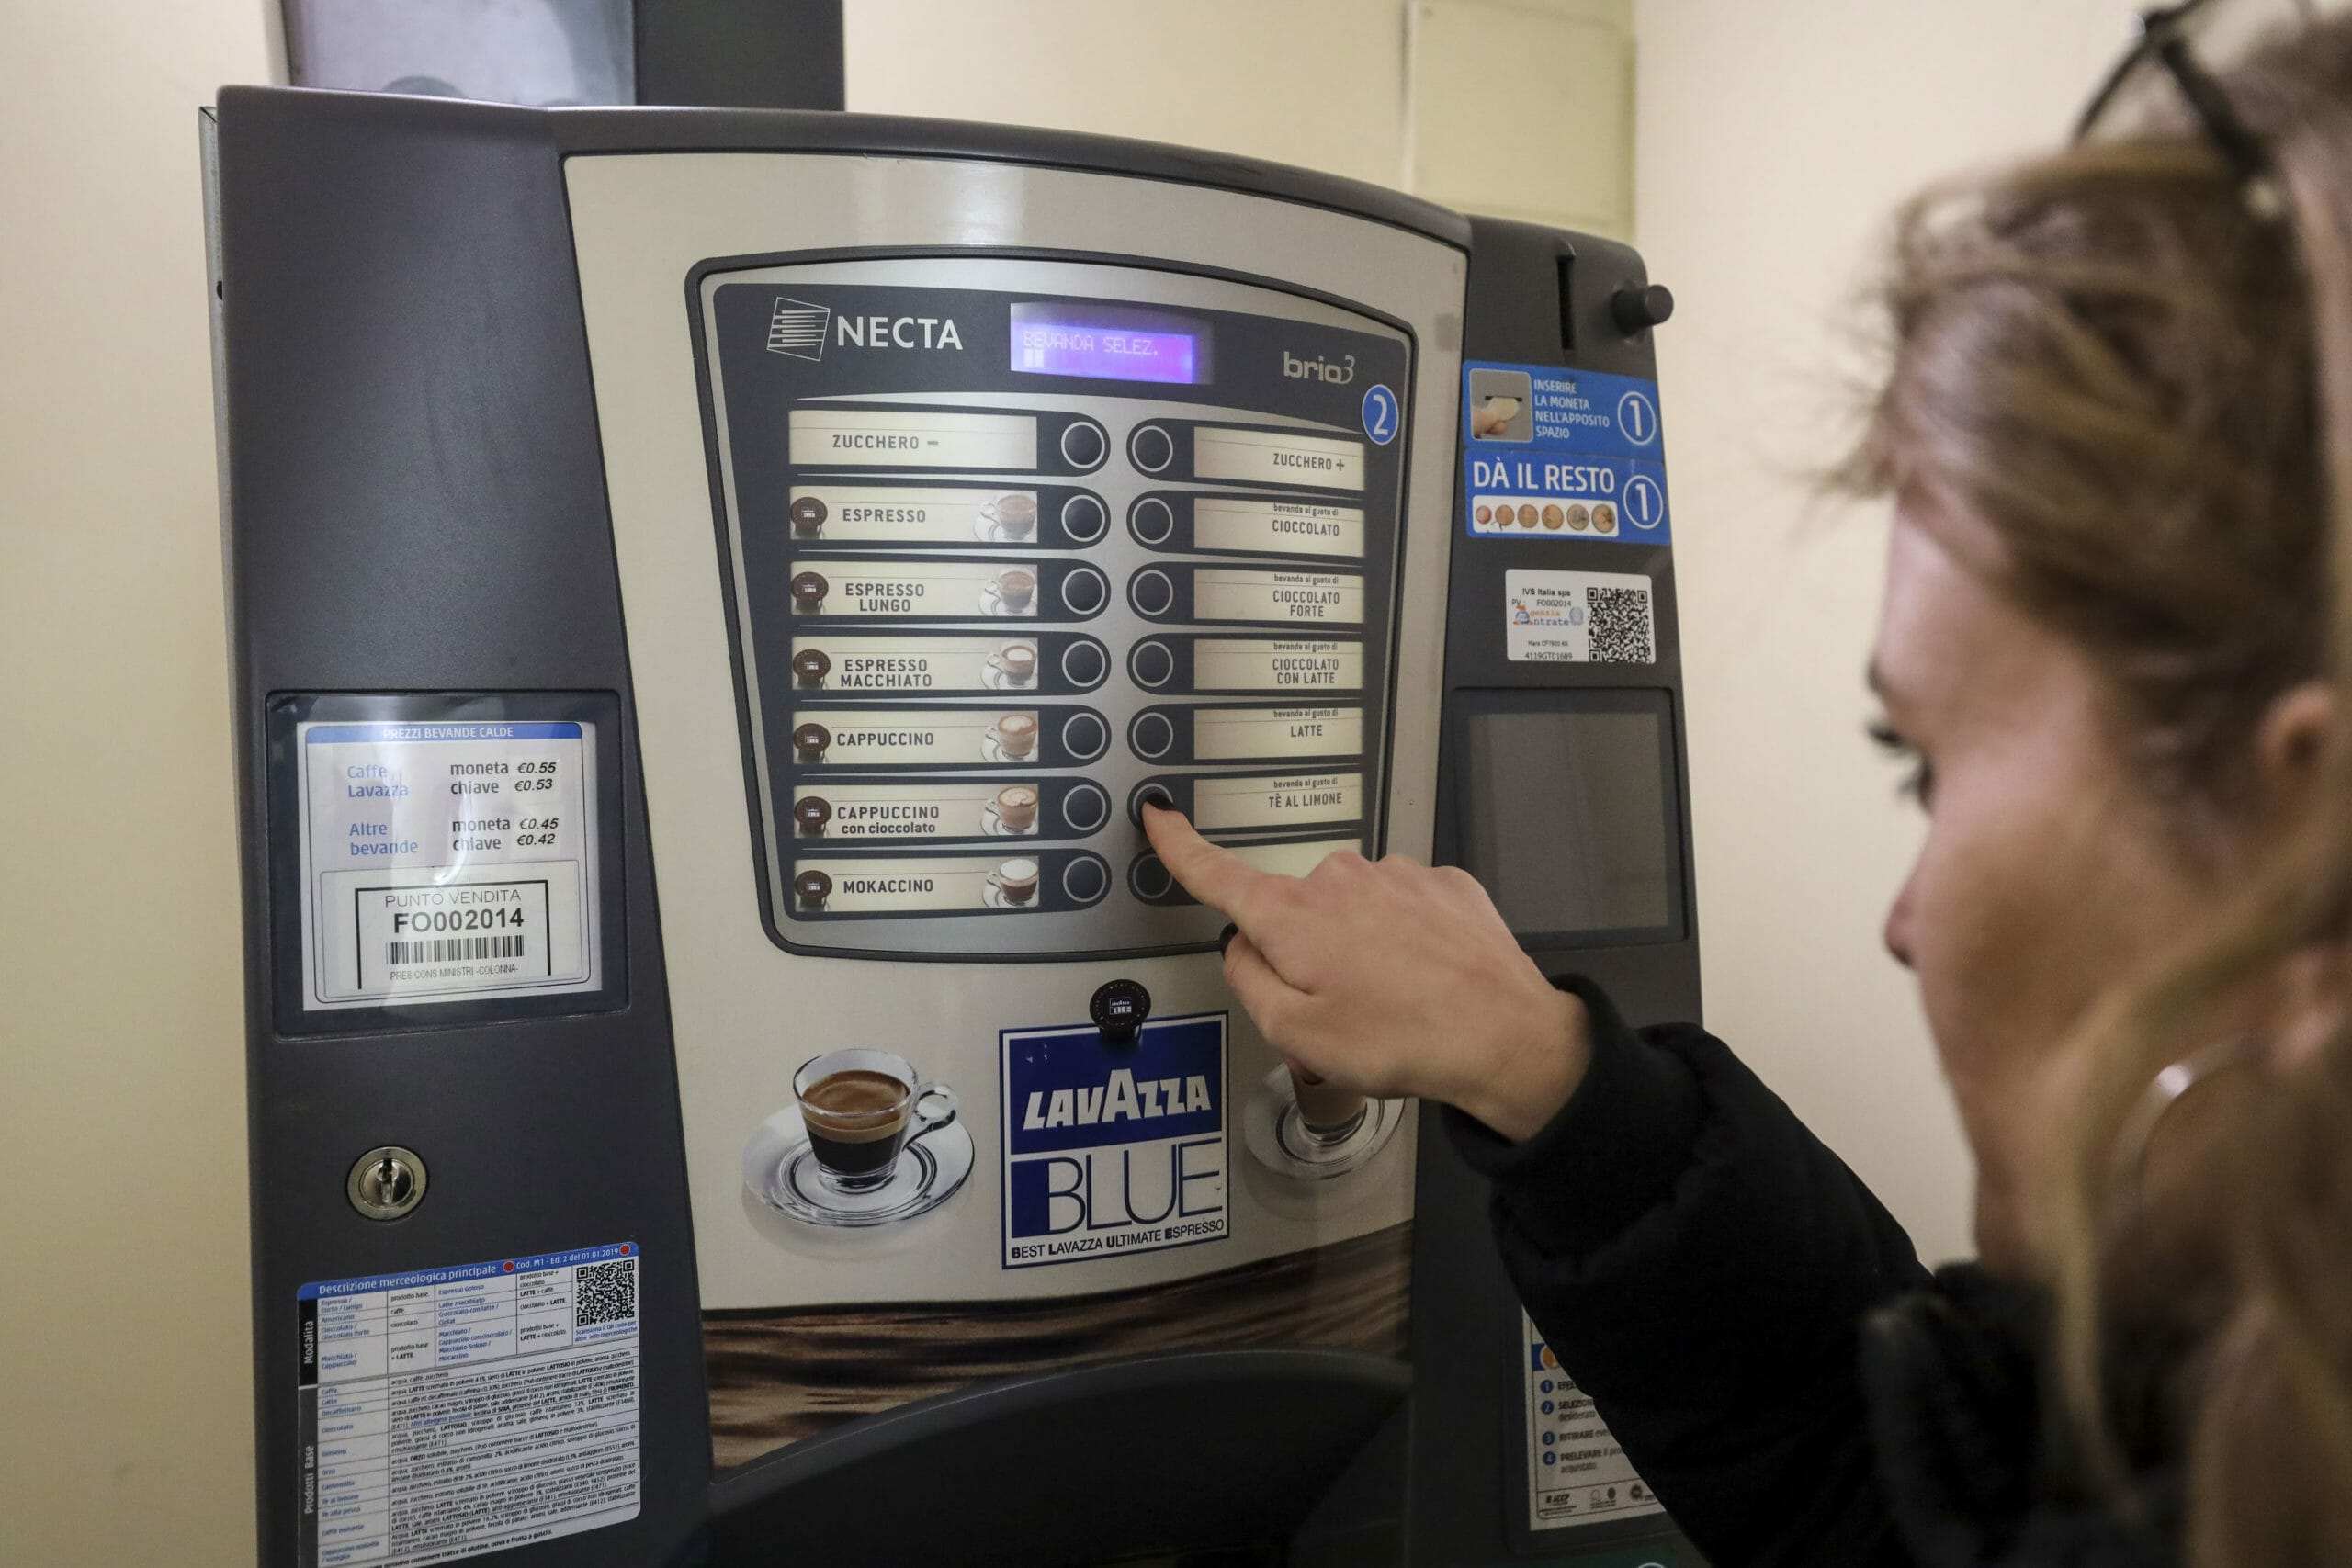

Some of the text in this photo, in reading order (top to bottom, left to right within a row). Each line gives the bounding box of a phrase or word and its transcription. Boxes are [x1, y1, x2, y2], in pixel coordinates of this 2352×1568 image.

[837, 315, 963, 351] NECTA
[1023, 331, 1159, 356] BEVANDA SELEZ.
[1534, 378, 1577, 394] INSERIRE
[1534, 394, 1590, 411] LA MONETA
[1372, 394, 1389, 436] 2
[1630, 400, 1643, 436] 1
[1536, 425, 1570, 439] SPAZIO
[831, 434, 920, 450] ZUCCHERO
[1273, 452, 1332, 471] ZUCCHERO
[1473, 456, 1615, 493] DÀ IL RESTO
[1273, 502, 1303, 513] bevanda
[1312, 507, 1331, 516] gusto
[1635, 483, 1648, 521] 1
[842, 508, 927, 524] ESPRESSO
[1272, 519, 1340, 536] CIOCCOLATO
[1273, 574, 1339, 586] bevanda al gusto di
[845, 582, 925, 598] ESPRESSO
[1272, 590, 1340, 604] CIOCCOLATO
[1538, 588, 1555, 596] Italia
[859, 598, 911, 613] LUNGO
[1290, 604, 1324, 617] FORTE
[1273, 642, 1338, 653] bevanda al gusto di
[843, 659, 928, 672] ESPRESSO
[1272, 658, 1340, 671] CIOCCOLATO
[840, 673, 932, 688] MACCHIATO
[1277, 672, 1335, 684] CON LATTE
[1273, 709, 1303, 717] bevanda
[1312, 709, 1331, 718] gusto
[1331, 708, 1339, 716] di
[382, 727, 514, 739] PREZZI BEVANDE CALDE
[1290, 725, 1323, 738] LATTE
[836, 732, 934, 747] CAPPUCCINO
[450, 761, 557, 775] moneta €0.55
[450, 778, 553, 795] chiave €0.53
[1273, 777, 1338, 788] bevanda al gusto di
[348, 784, 408, 798] Lavazza
[1269, 792, 1342, 808] TÈ AL LIMONE
[837, 806, 940, 820] CAPPUCCINO
[349, 822, 388, 837] Altre
[452, 818, 559, 832] moneta €0.45
[842, 822, 936, 835] con cioccolato
[351, 840, 419, 856] bevande
[453, 833, 555, 852] chiave €0.42
[842, 879, 933, 894] MOKACCINO
[385, 889, 521, 908] PUNTO VENDITA
[394, 908, 524, 933] FO002014
[390, 970, 413, 981] PRES
[413, 968, 438, 979] CONS
[439, 966, 474, 978] MINISTRI
[1023, 1067, 1212, 1131] LAVAZZA
[1034, 1137, 1223, 1235] BLUE
[1012, 1219, 1225, 1259] BEST LAVAZZA ULTIMATE ESPRESSO
[516, 1260, 533, 1269] Cod.
[534, 1258, 544, 1267] M1
[550, 1256, 562, 1265] Ed.
[570, 1254, 581, 1262] del
[582, 1248, 619, 1259] 01.01.2019
[319, 1265, 496, 1295] Descrizione merceologica principale
[304, 1445, 314, 1470] Base
